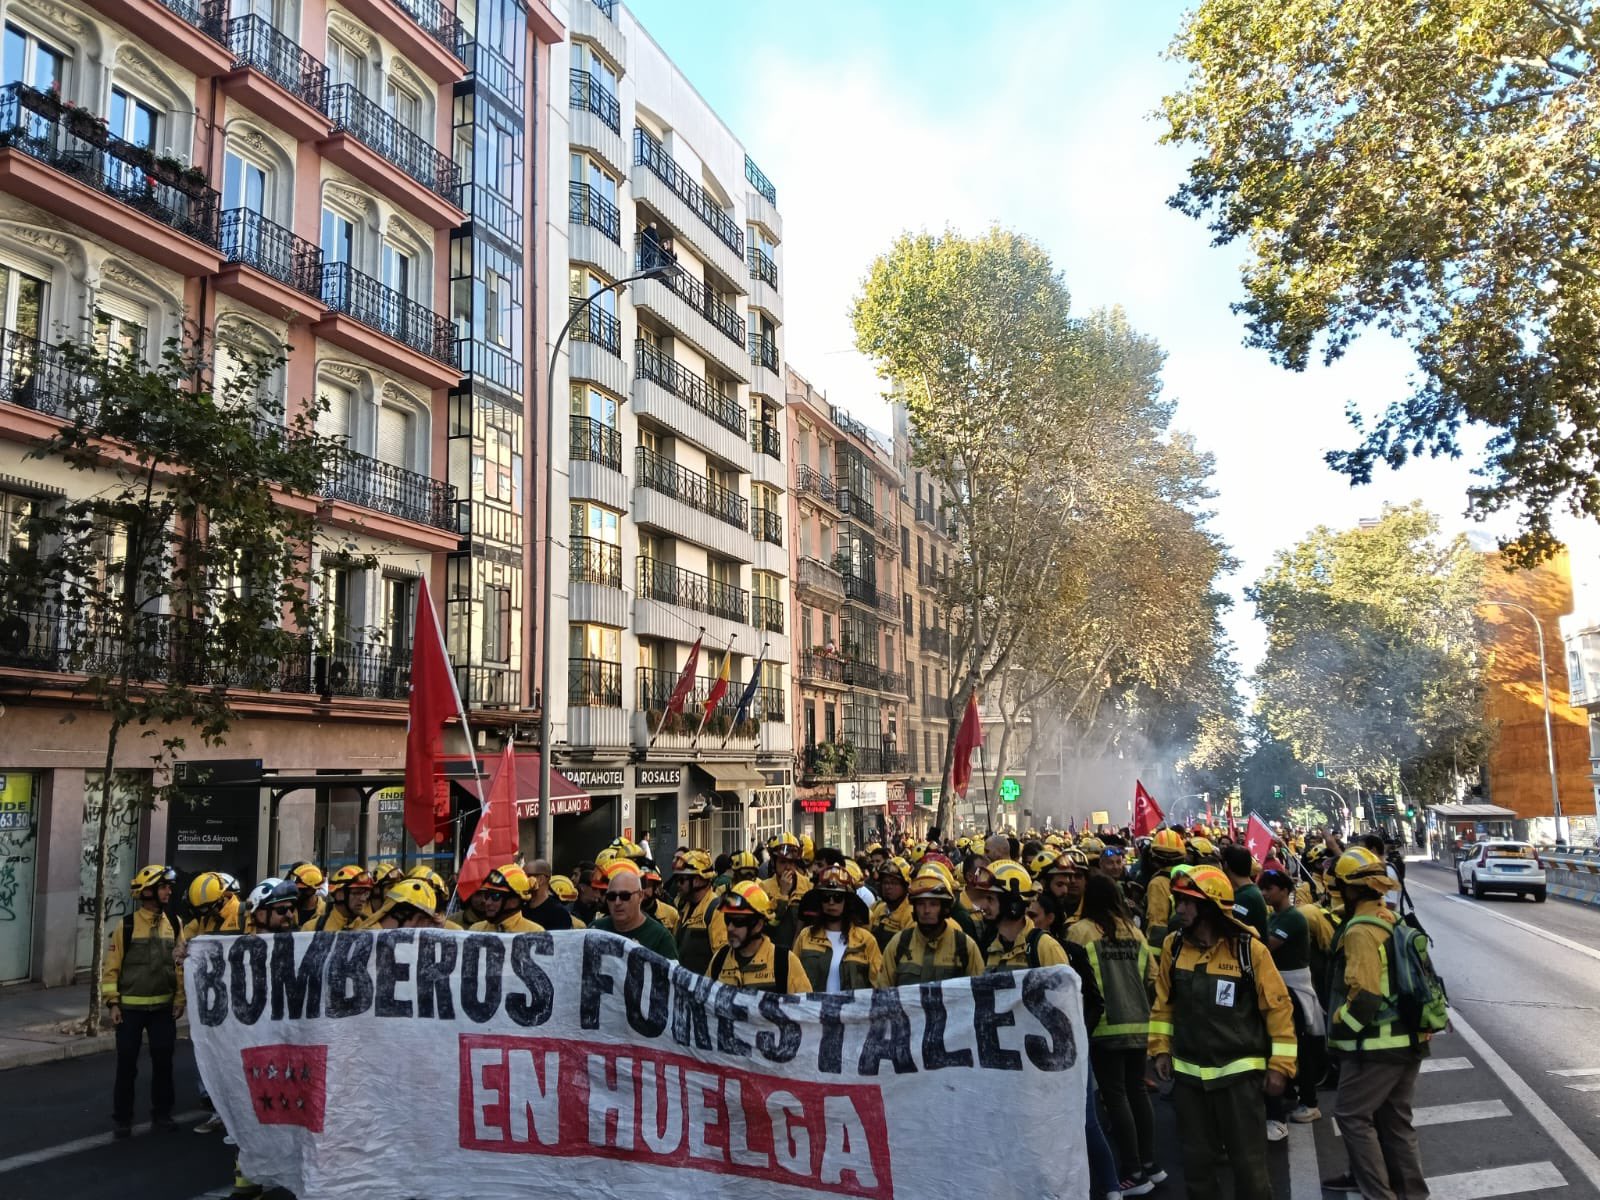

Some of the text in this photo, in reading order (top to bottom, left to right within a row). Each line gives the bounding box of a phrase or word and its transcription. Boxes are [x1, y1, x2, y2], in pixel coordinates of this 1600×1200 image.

[556, 799, 581, 814] MILANO
[641, 770, 680, 784] ROSALES
[193, 929, 1078, 1076] BOMBEROS FORESTALES
[470, 1048, 879, 1188] EN HUELGA
